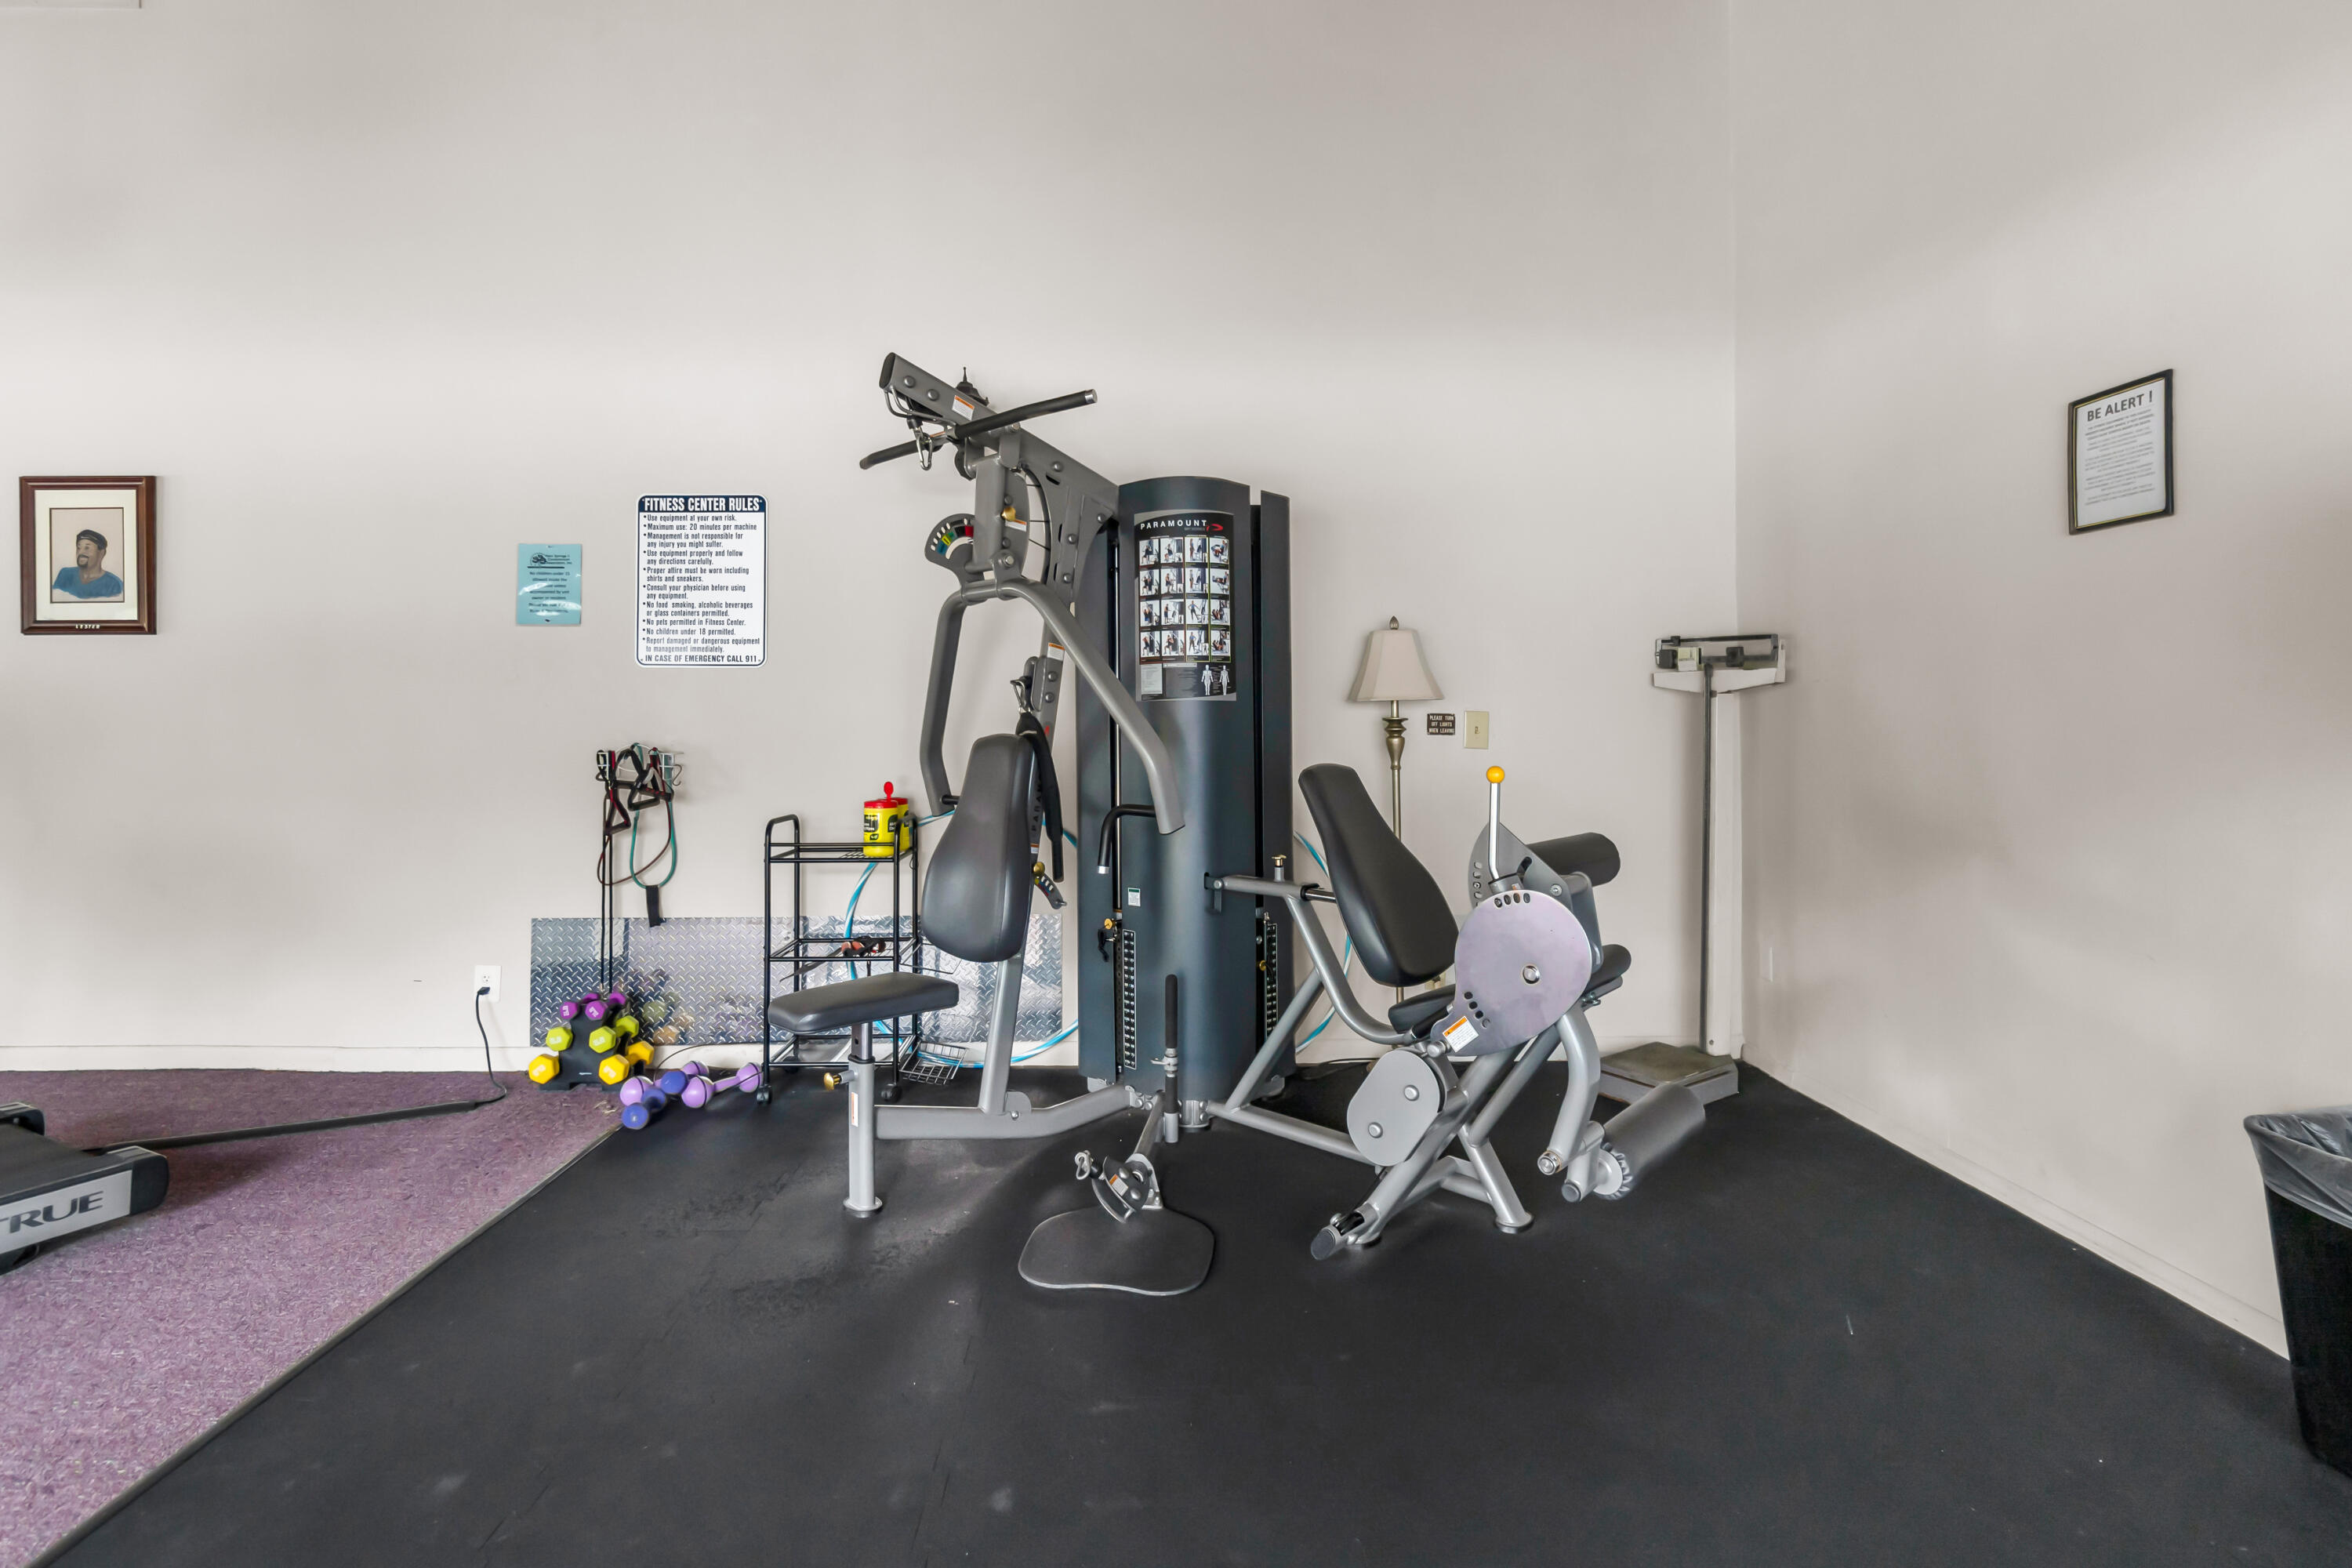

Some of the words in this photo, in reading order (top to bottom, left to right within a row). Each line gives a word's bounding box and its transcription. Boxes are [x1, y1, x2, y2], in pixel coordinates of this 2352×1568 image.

[2087, 407, 2102, 422] BE
[2104, 394, 2144, 416] ALERT
[2149, 390, 2153, 403] !
[644, 498, 684, 511] FITNESS
[688, 498, 725, 511] CENTER
[729, 498, 760, 511] RULES
[1140, 520, 1207, 530] PARAMOUNT
[0, 1191, 103, 1233] RUE
